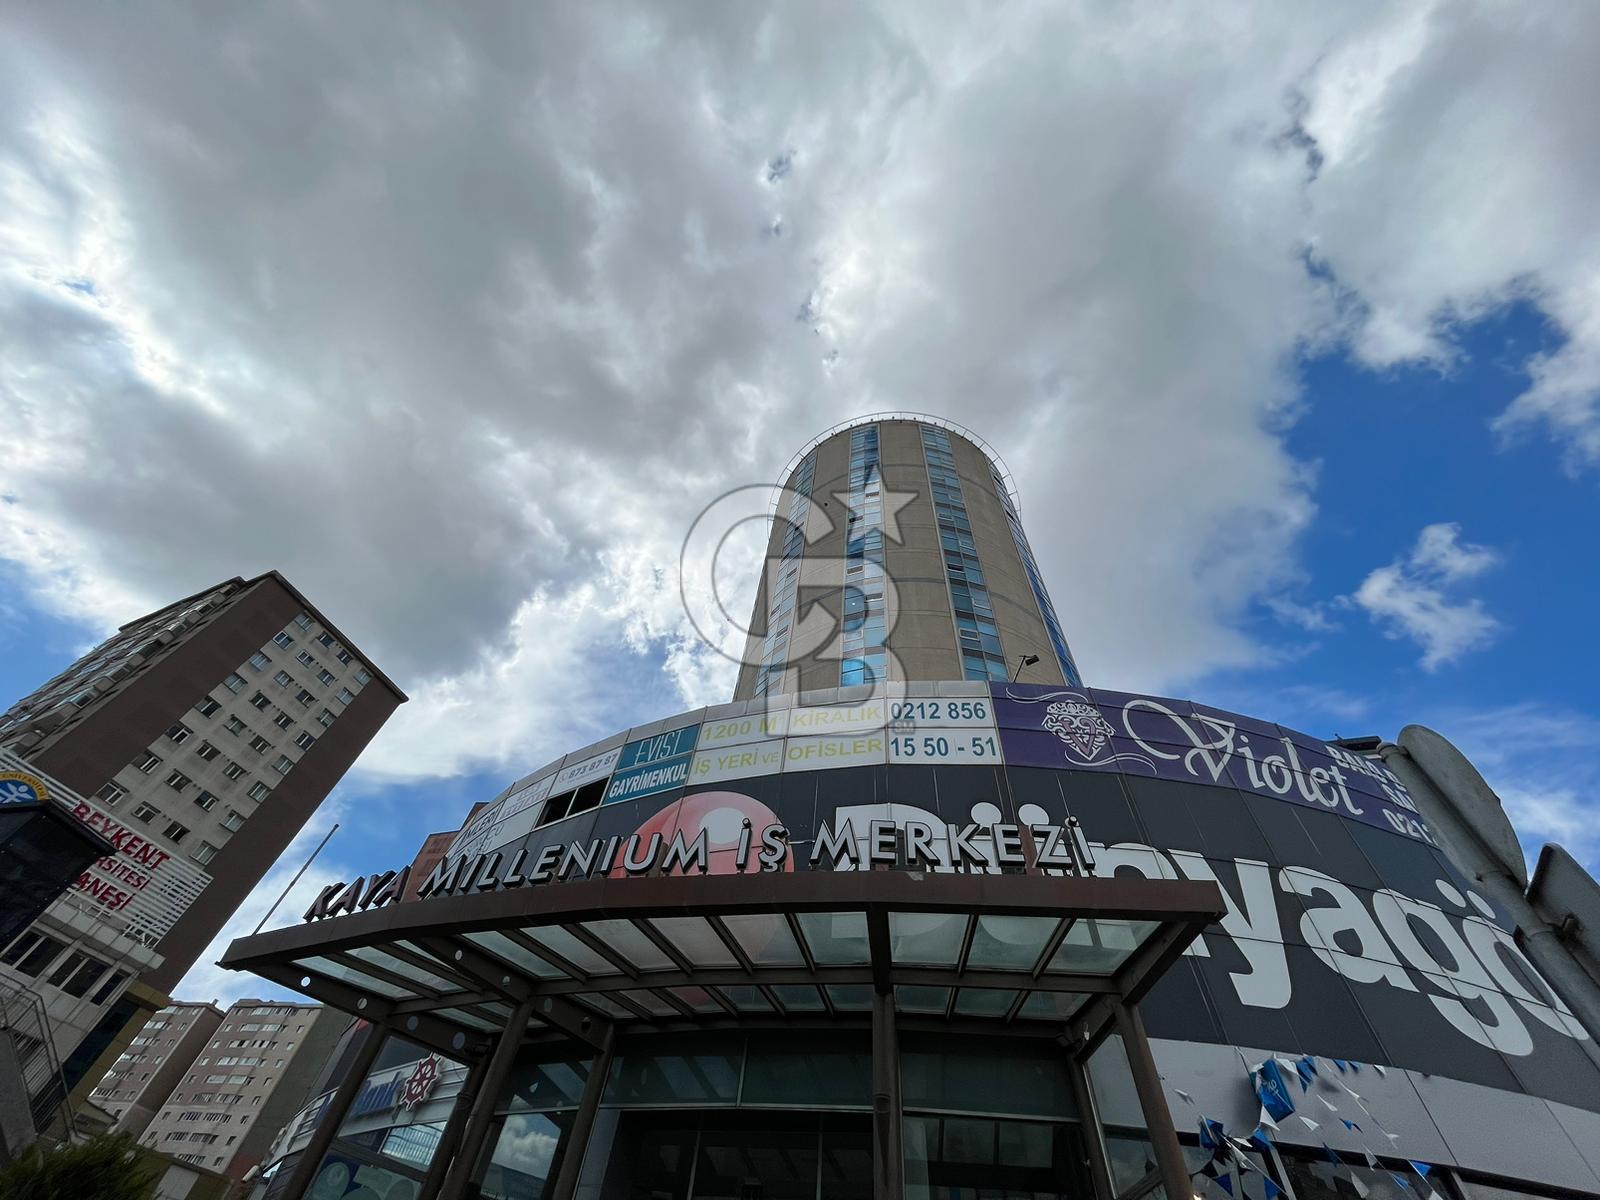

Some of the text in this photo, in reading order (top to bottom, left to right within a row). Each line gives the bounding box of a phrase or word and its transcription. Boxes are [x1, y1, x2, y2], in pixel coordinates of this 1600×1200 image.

[705, 720, 752, 741] 1200
[792, 705, 881, 727] KİRALIK
[891, 702, 986, 720] 0212 856
[717, 748, 759, 770] YERİ
[787, 738, 883, 761] OFİSLER
[891, 736, 916, 757] 15
[923, 736, 949, 757] 50
[972, 736, 997, 757] 51
[1121, 698, 1364, 816] Violet
[608, 762, 688, 799] GAYRİMENKUL
[95, 855, 153, 891] RSİTESİ
[302, 865, 411, 921] KAYA
[417, 826, 708, 898] MILLENIUM
[735, 817, 790, 873] İŞ
[810, 815, 1097, 870] MERKEZİ
[75, 871, 137, 911] ANESİ
